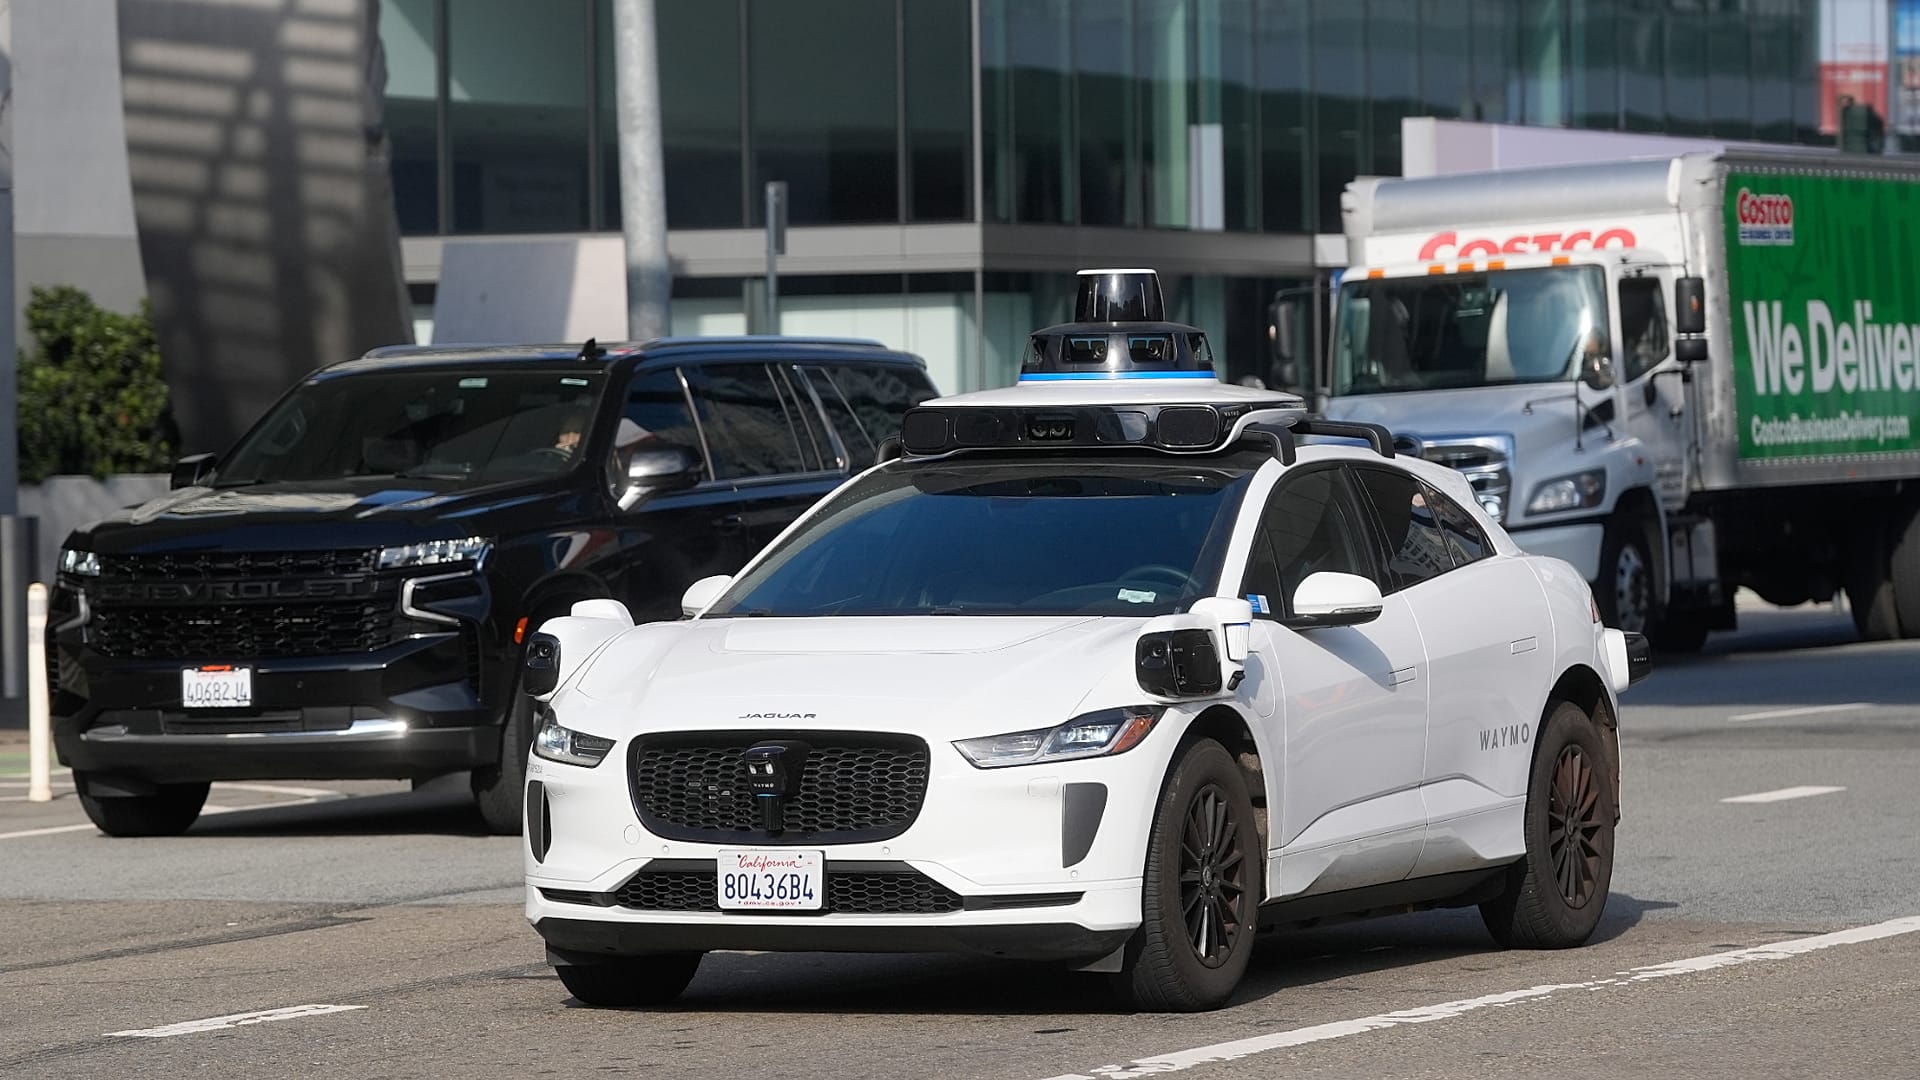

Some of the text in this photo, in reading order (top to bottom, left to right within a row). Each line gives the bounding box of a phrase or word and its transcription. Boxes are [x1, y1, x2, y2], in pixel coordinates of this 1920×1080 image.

[1739, 189, 1793, 224] COSTCO
[1743, 300, 1804, 395] We
[1751, 411, 1910, 446] CostcoBusinessDelivery.com
[101, 579, 367, 600] CHEVROLET
[1480, 723, 1530, 751] WAYMO
[739, 854, 803, 872] California
[725, 873, 814, 900] 80436B4
